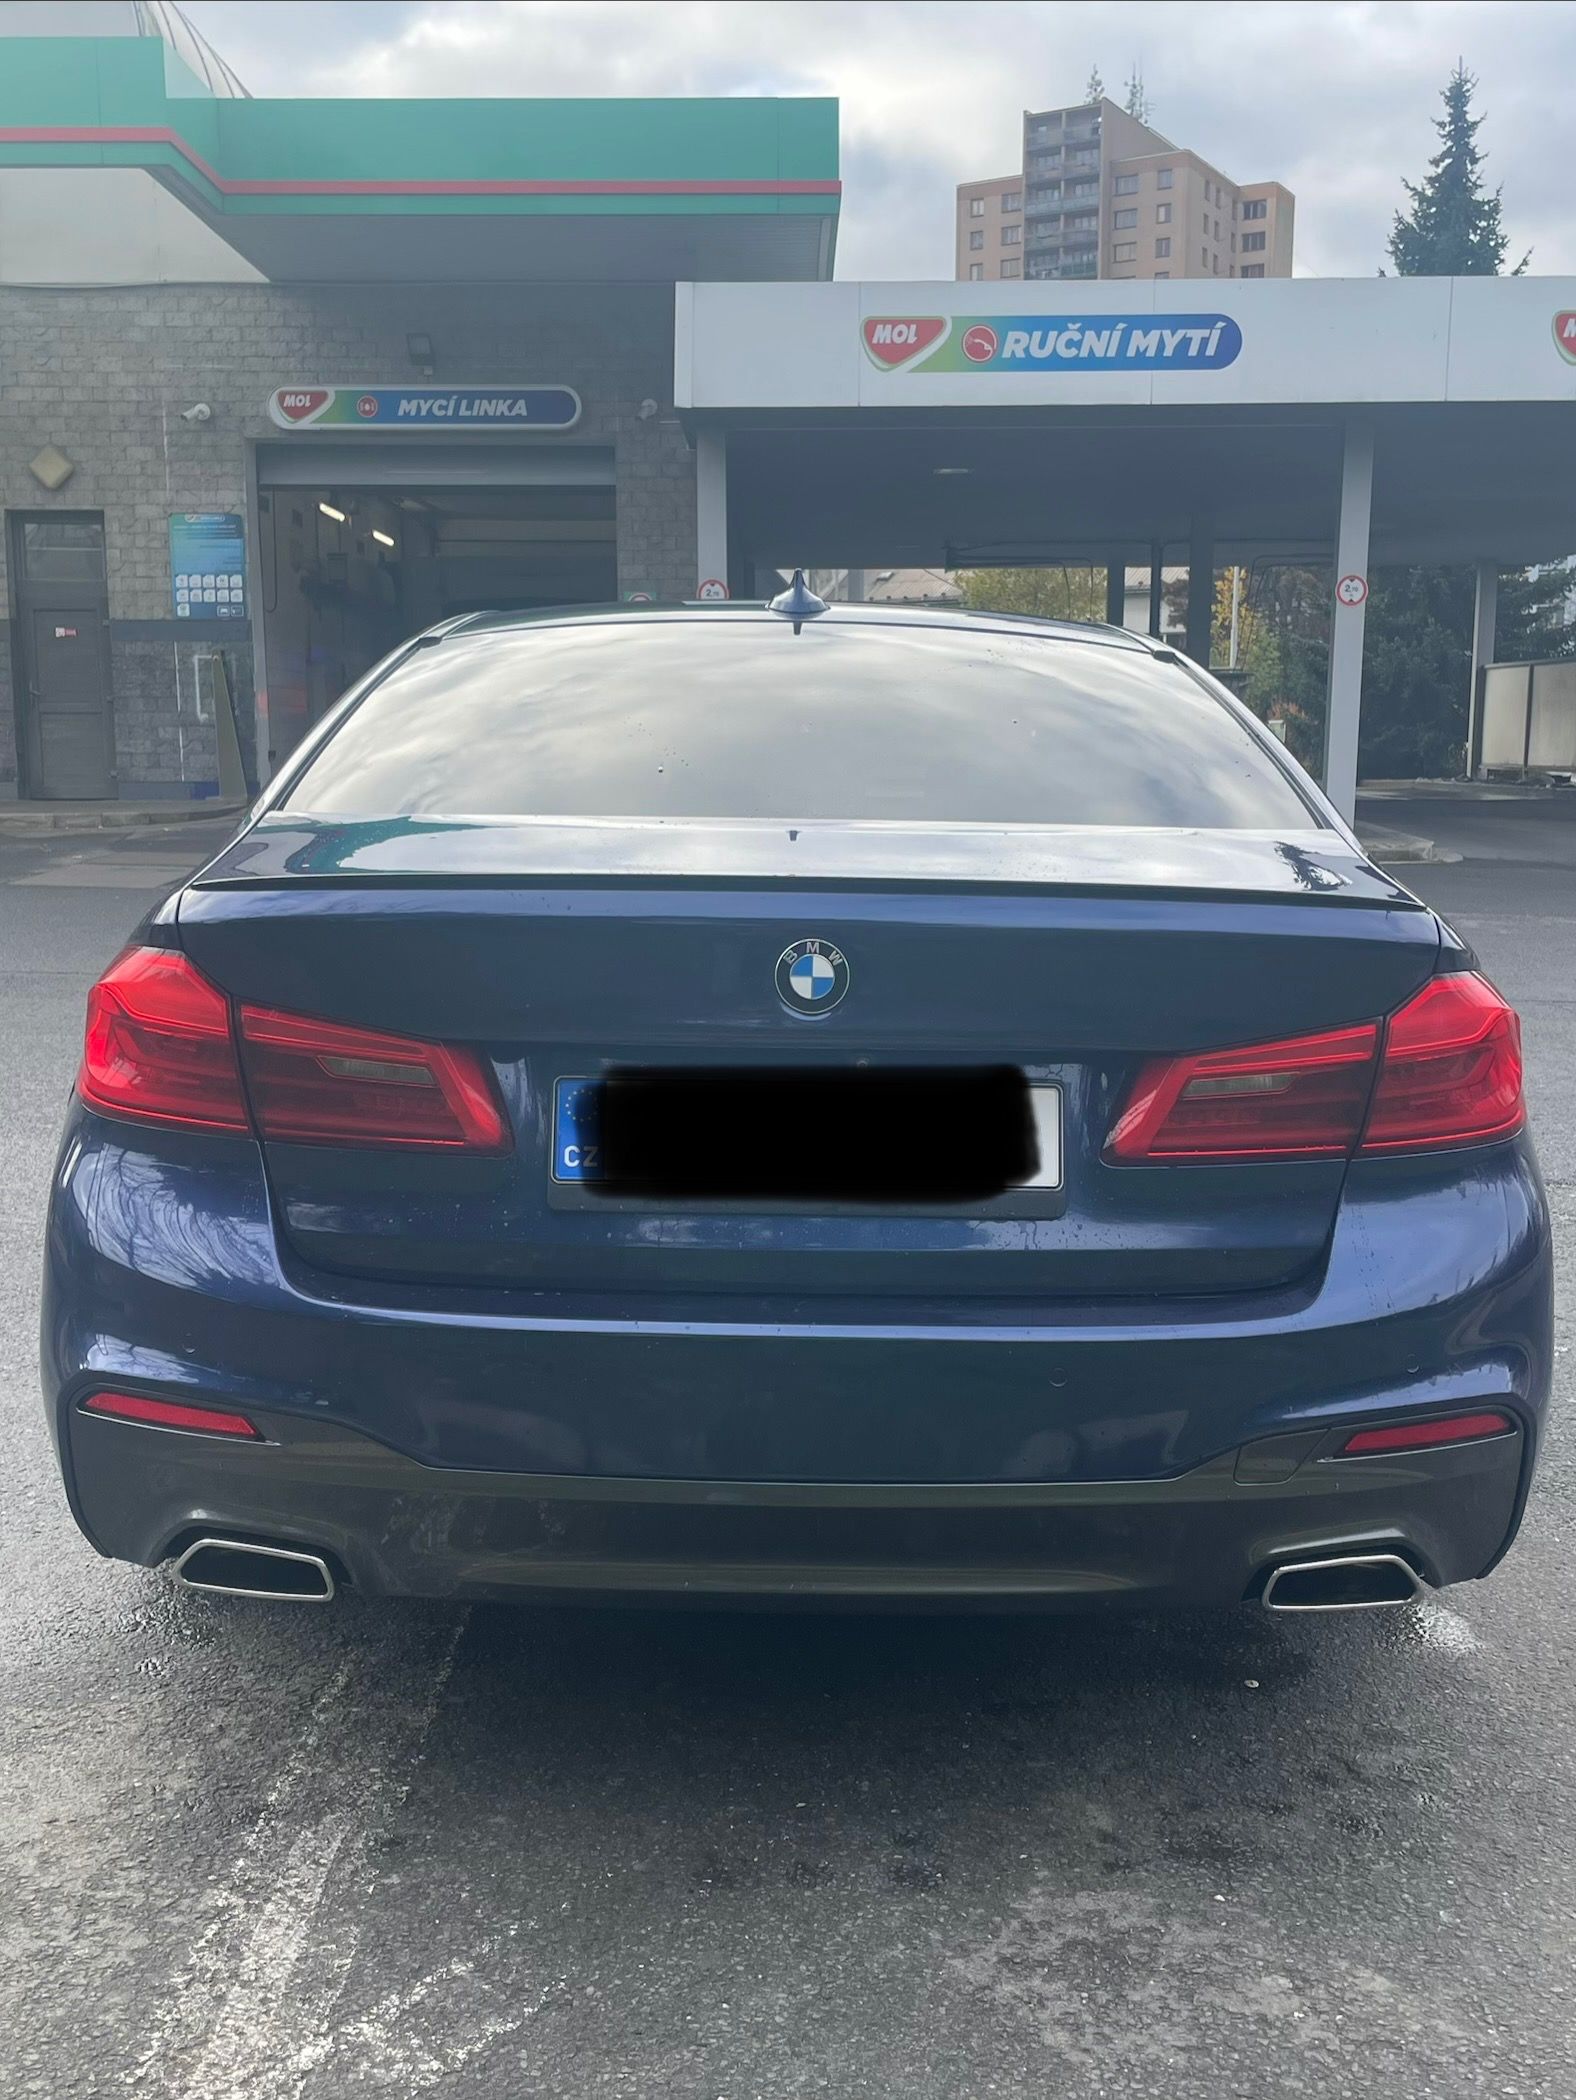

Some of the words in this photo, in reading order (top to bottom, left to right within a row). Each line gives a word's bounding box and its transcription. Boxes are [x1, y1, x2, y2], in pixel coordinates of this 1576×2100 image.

[872, 324, 918, 344] MOL
[1002, 323, 1128, 358] RUČNÍ
[1127, 321, 1227, 357] MYTÍ
[284, 394, 312, 408] MOL
[398, 395, 458, 417] MYCÍ
[458, 399, 528, 417] LINKA
[783, 941, 843, 966] BMW
[564, 1145, 599, 1168] CZ
